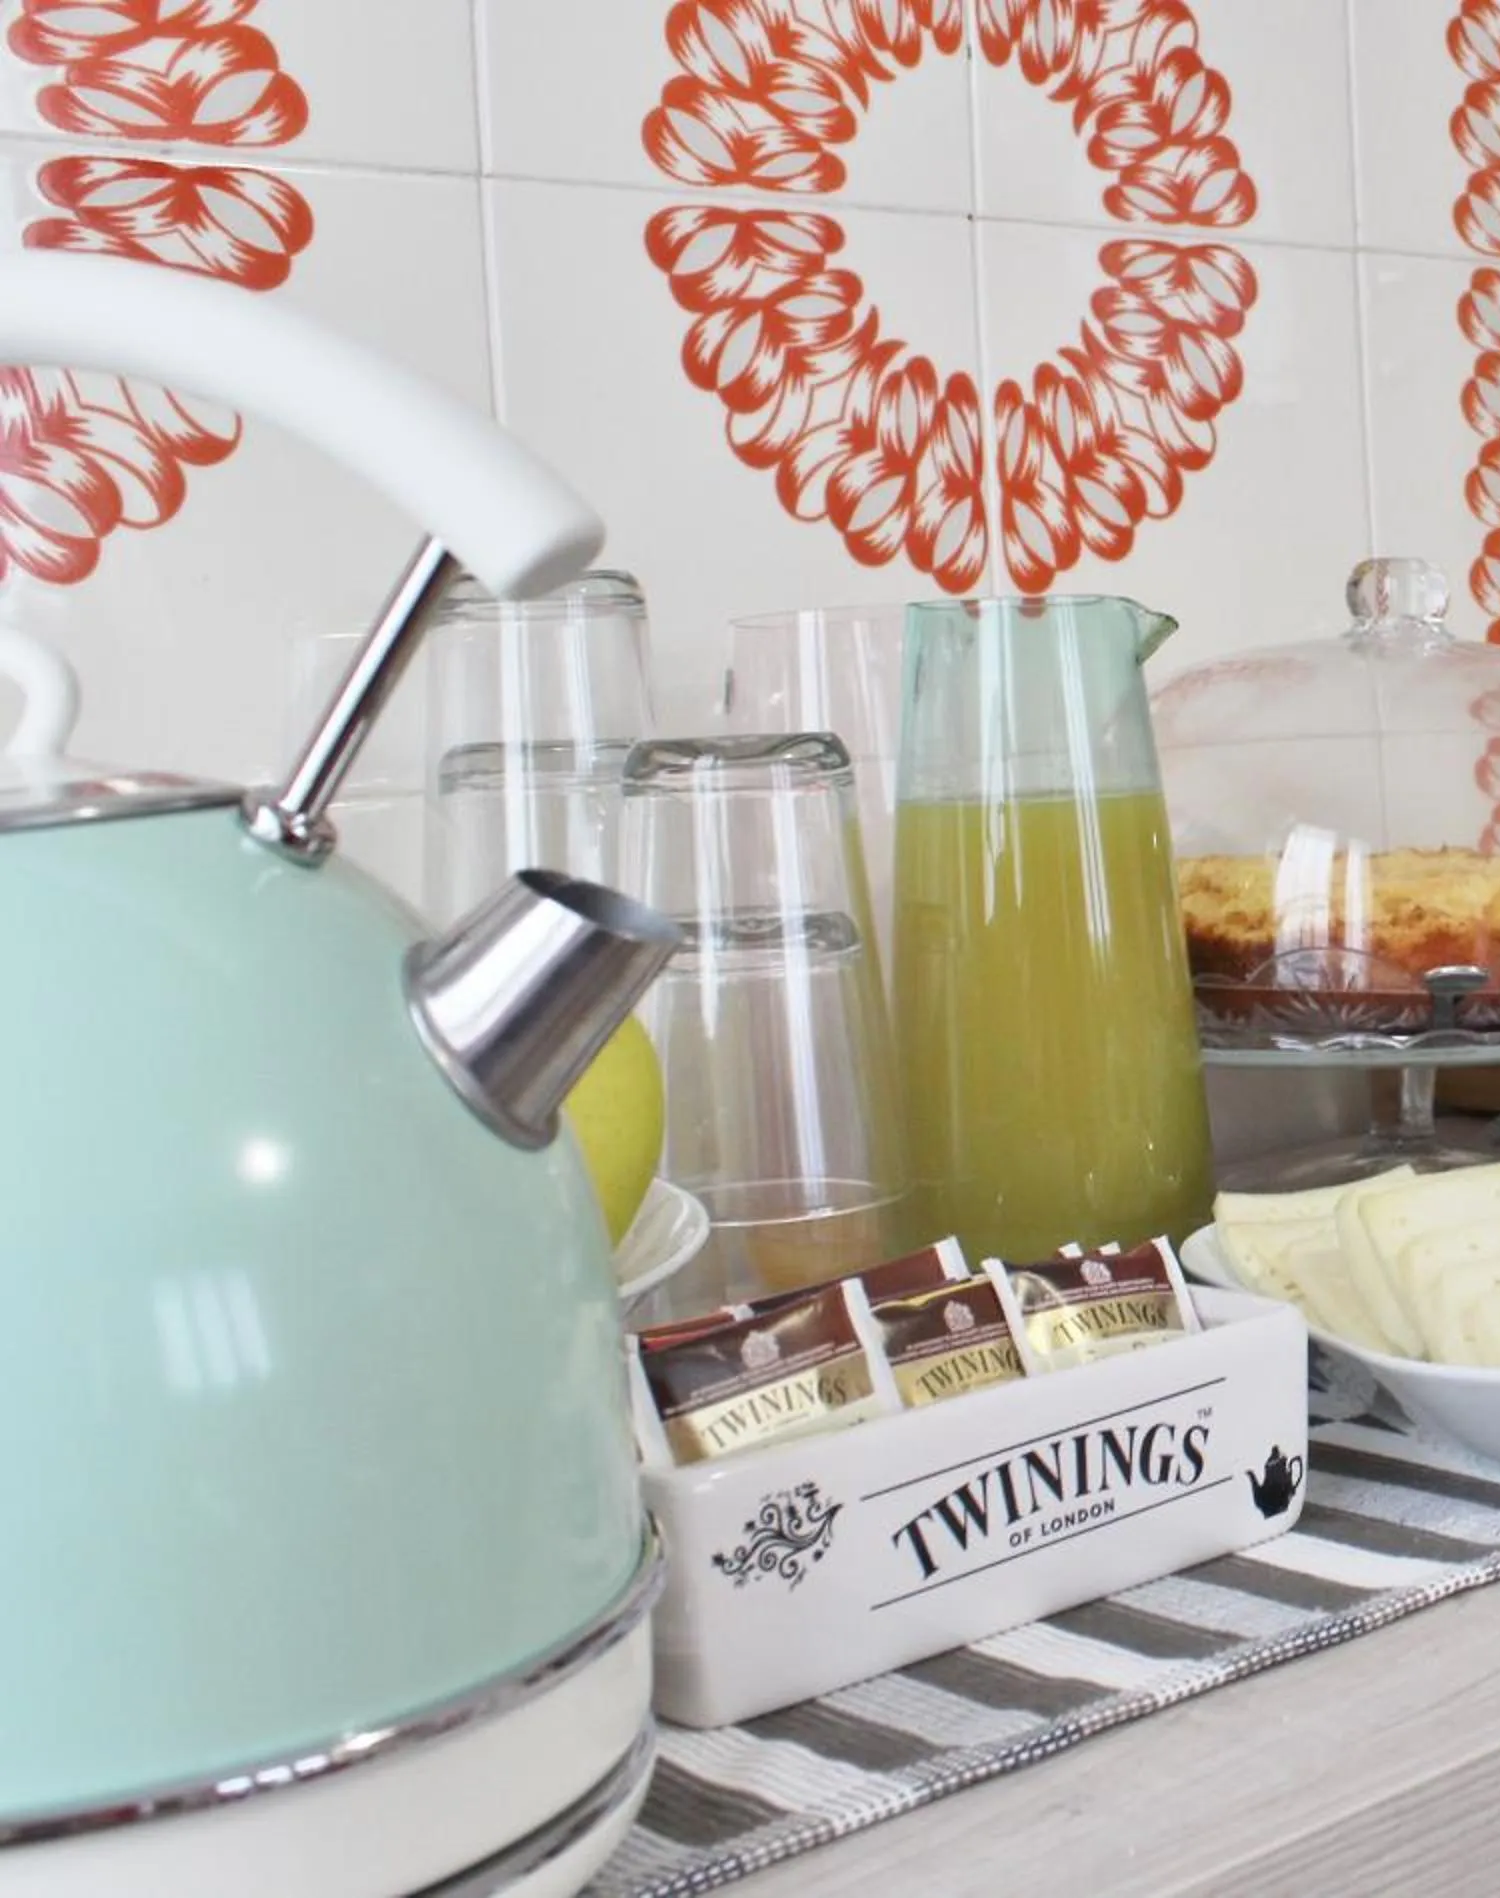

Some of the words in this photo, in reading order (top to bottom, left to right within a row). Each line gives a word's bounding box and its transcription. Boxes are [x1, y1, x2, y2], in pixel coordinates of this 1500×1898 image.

[1053, 1300, 1168, 1344] TWININGS
[700, 1373, 848, 1449] TWININGS
[891, 1422, 1210, 1580] TWININGS
[1009, 1529, 1033, 1549] OF
[1041, 1498, 1116, 1537] LONDON
